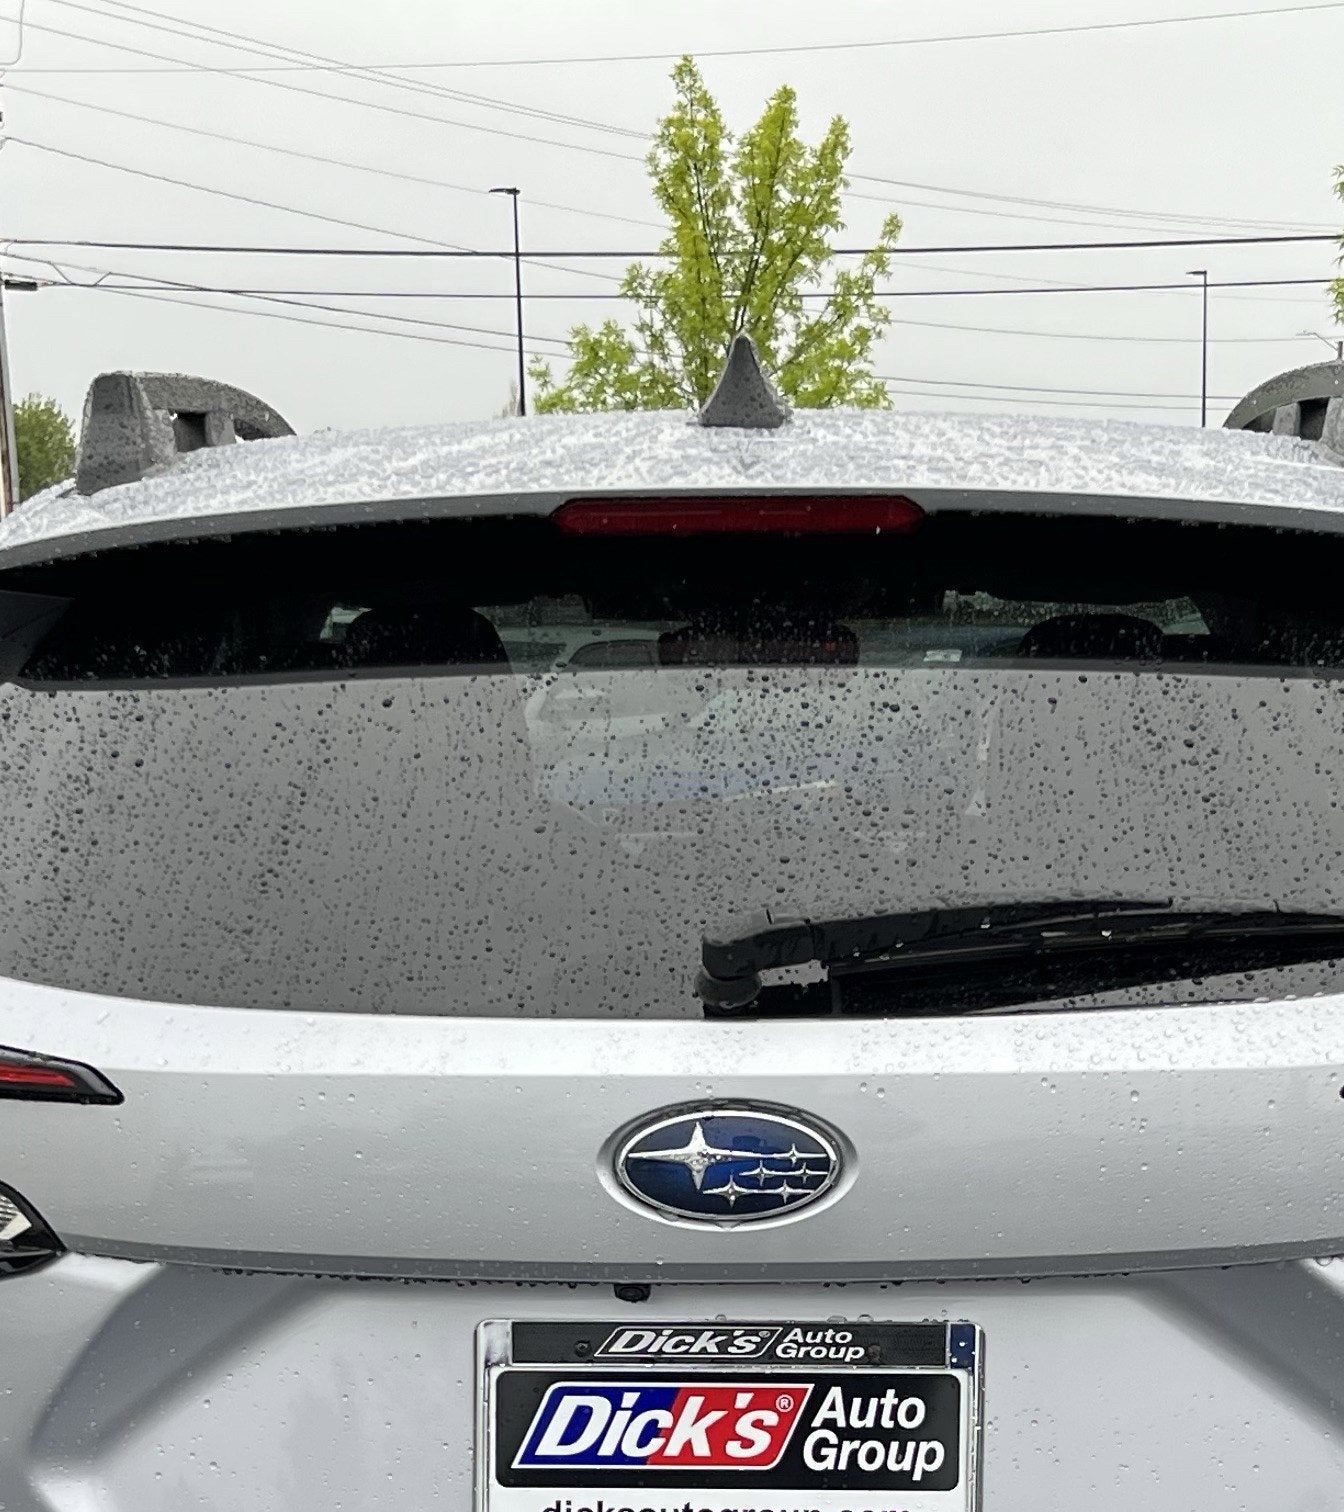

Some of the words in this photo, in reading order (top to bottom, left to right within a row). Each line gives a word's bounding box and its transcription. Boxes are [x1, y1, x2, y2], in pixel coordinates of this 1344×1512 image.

[783, 1328, 854, 1344] Auto
[775, 1343, 866, 1362] Group
[813, 1387, 926, 1429] Auto
[803, 1432, 945, 1480] Group
